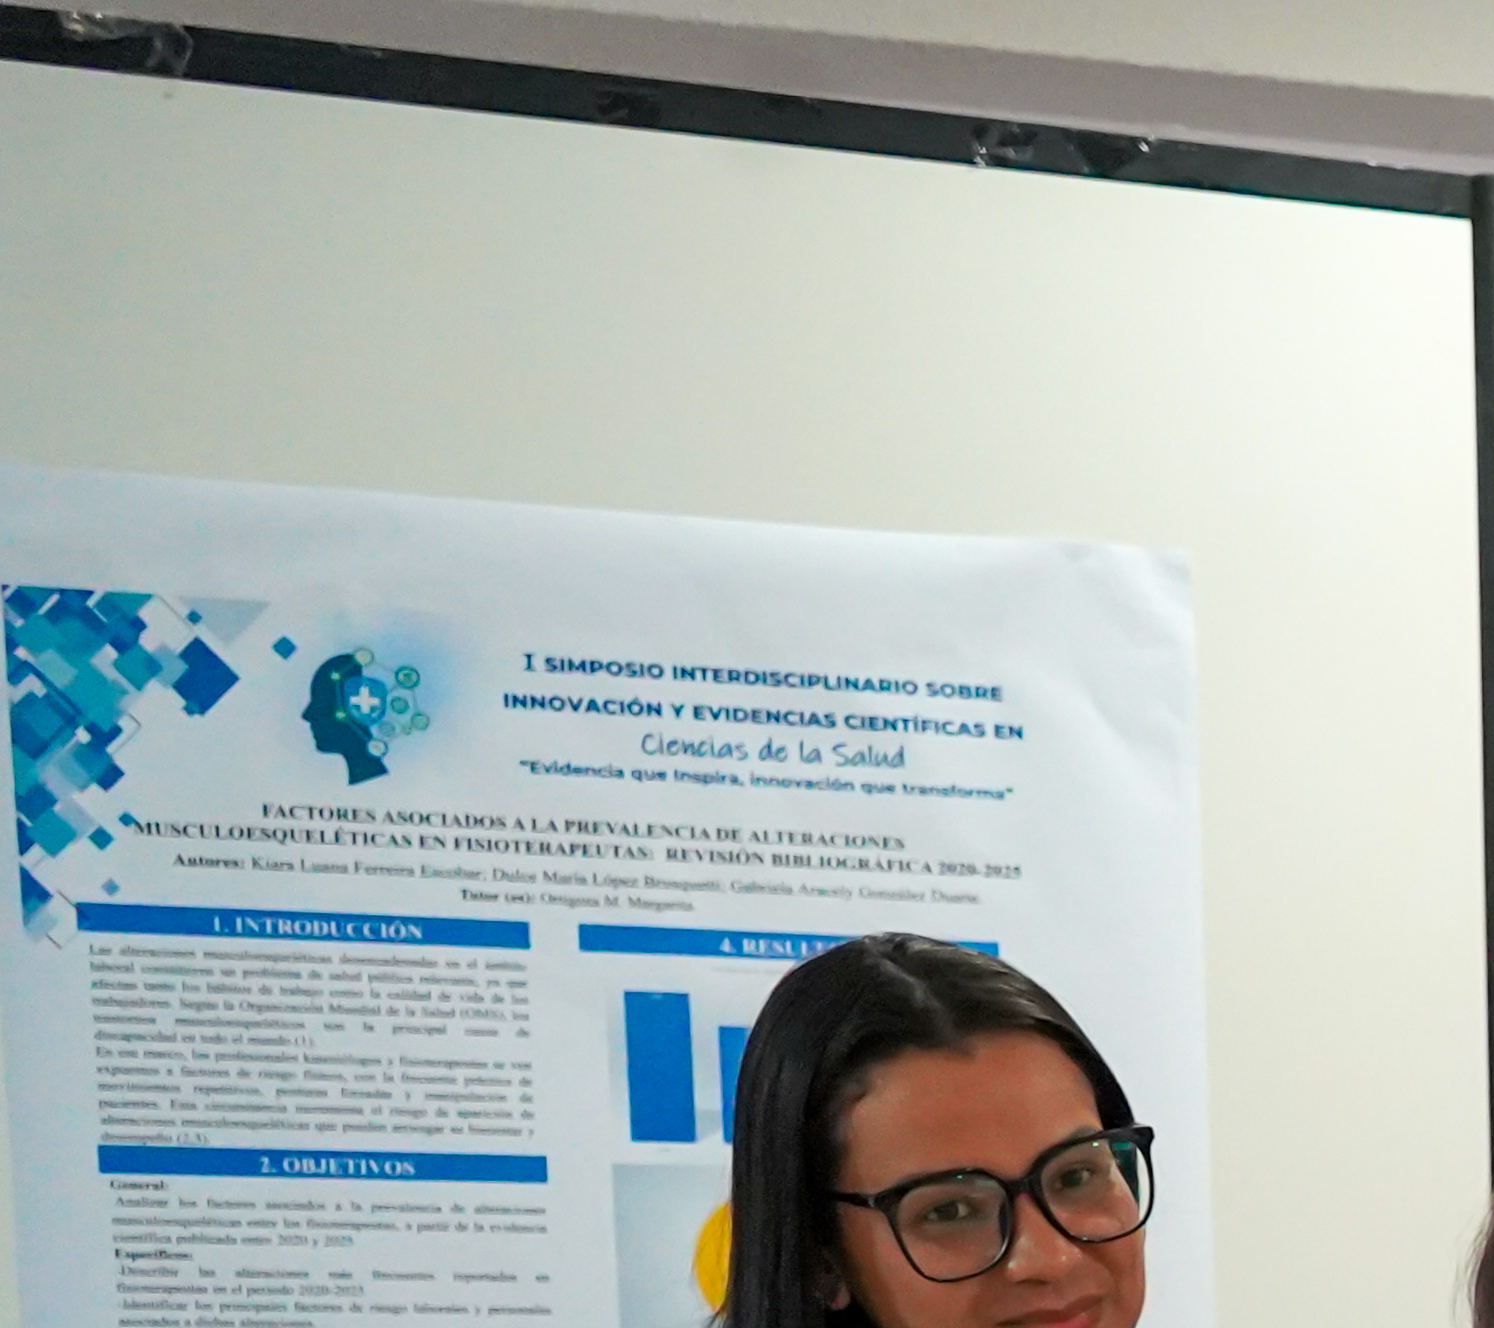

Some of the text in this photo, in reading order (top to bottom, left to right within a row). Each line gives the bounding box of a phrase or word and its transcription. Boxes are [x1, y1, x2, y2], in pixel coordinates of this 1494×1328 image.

[524, 653, 1002, 703] I SIMPOSIO INTERDISCIPLINARIO SOBRE
[503, 692, 1024, 740] INNOVACIÓN Y EVIDENCIAS CIENTÍFICAS EN
[640, 733, 905, 769] Ciencias de la Salud
